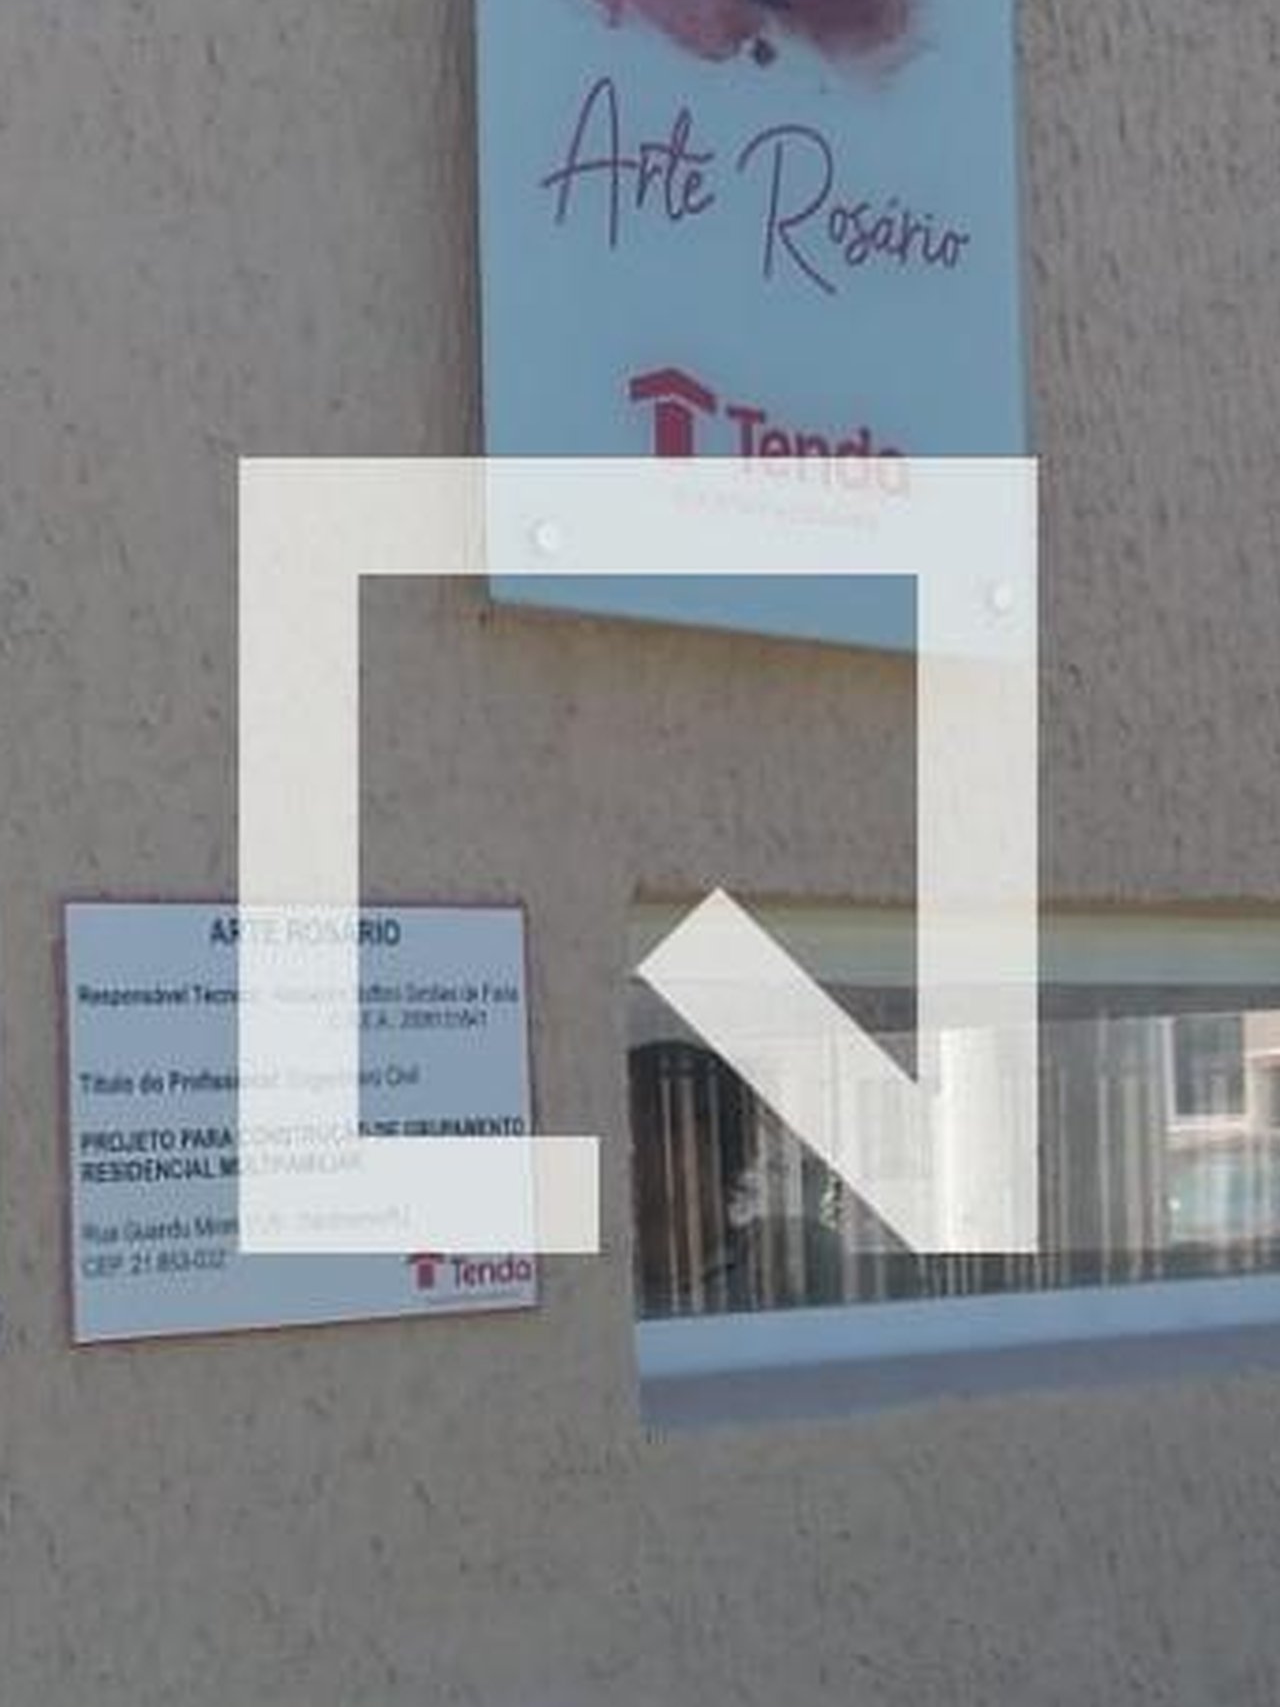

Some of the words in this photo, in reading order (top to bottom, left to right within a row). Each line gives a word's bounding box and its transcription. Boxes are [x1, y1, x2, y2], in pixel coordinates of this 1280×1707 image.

[542, 77, 715, 249] Arte
[736, 124, 972, 295] Rosário
[81, 1128, 175, 1153] PROJETO
[180, 1126, 233, 1149] PARA
[81, 1158, 217, 1183] RESIDENCIAL
[451, 1252, 532, 1289] Tenda
